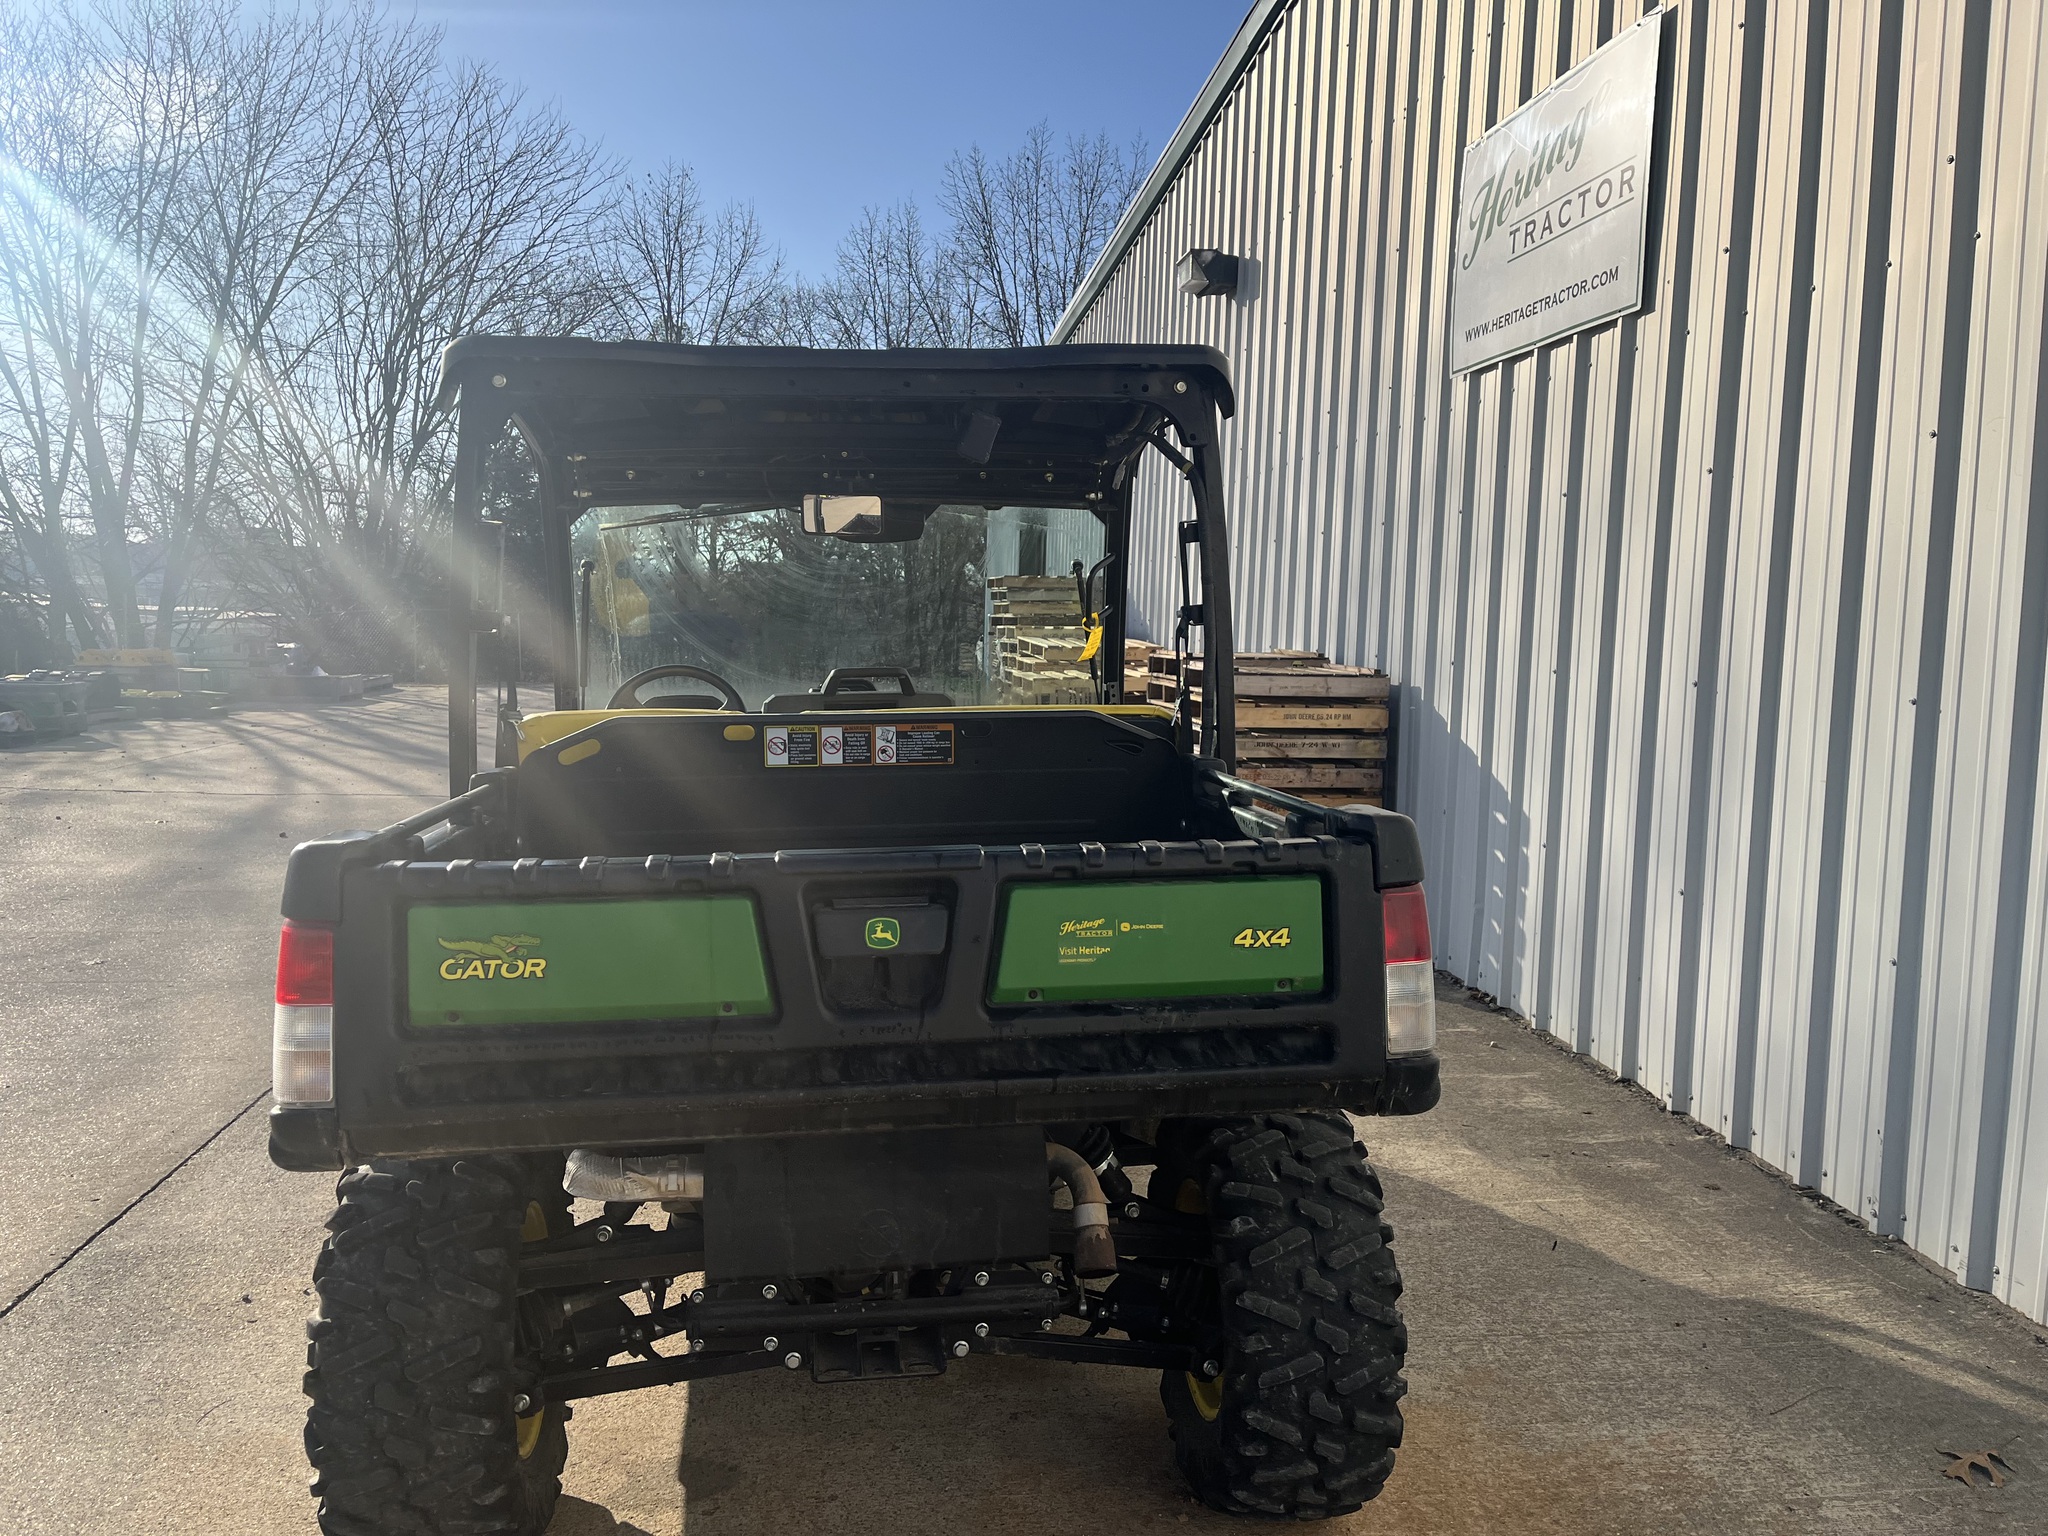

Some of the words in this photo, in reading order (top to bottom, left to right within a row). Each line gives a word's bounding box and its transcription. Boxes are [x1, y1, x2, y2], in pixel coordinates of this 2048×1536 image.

[1508, 164, 1635, 255] TRACTOR
[1464, 265, 1619, 343] WWW.HERITAGETRACTOR.COM
[1059, 918, 1105, 936] Heritage
[1059, 946, 1077, 956] Visit
[439, 957, 548, 981] GATOR
